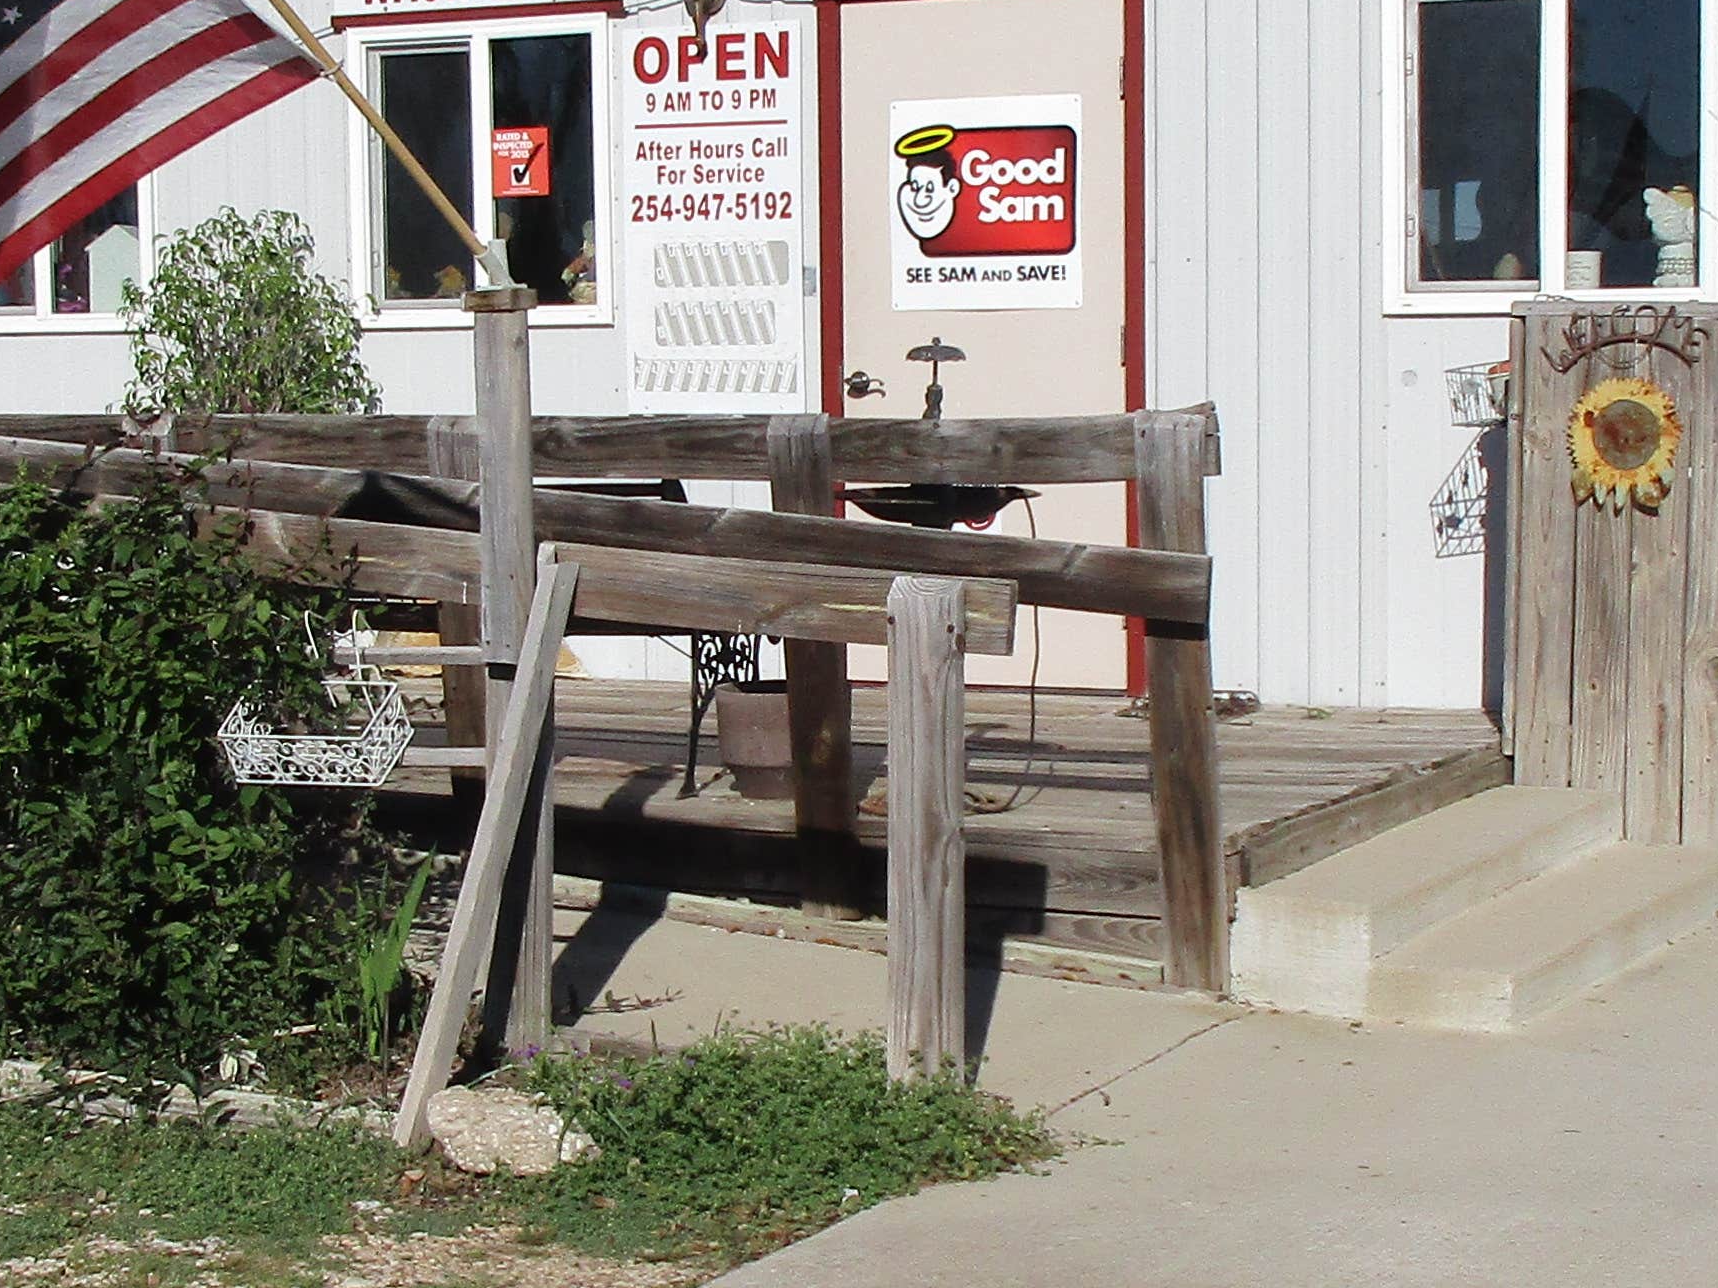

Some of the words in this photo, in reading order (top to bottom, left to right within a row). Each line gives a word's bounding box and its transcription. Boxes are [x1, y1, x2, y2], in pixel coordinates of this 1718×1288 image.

[633, 30, 790, 85] OPEN
[645, 92, 656, 113] 9
[663, 91, 691, 112] AM
[699, 90, 724, 111] TO
[731, 89, 742, 109] 9
[749, 88, 776, 109] PM
[635, 140, 682, 161] After
[689, 139, 744, 159] Hours
[751, 137, 788, 158] Call
[657, 165, 686, 185] For
[693, 163, 765, 184] Service
[961, 147, 1065, 186] Good
[631, 191, 793, 222] 254-947-5192
[977, 186, 1065, 223] Sam
[906, 267, 932, 283] SEE
[938, 267, 977, 282] SAM
[978, 270, 1012, 281] AND
[1016, 265, 1066, 281] SAVE!
